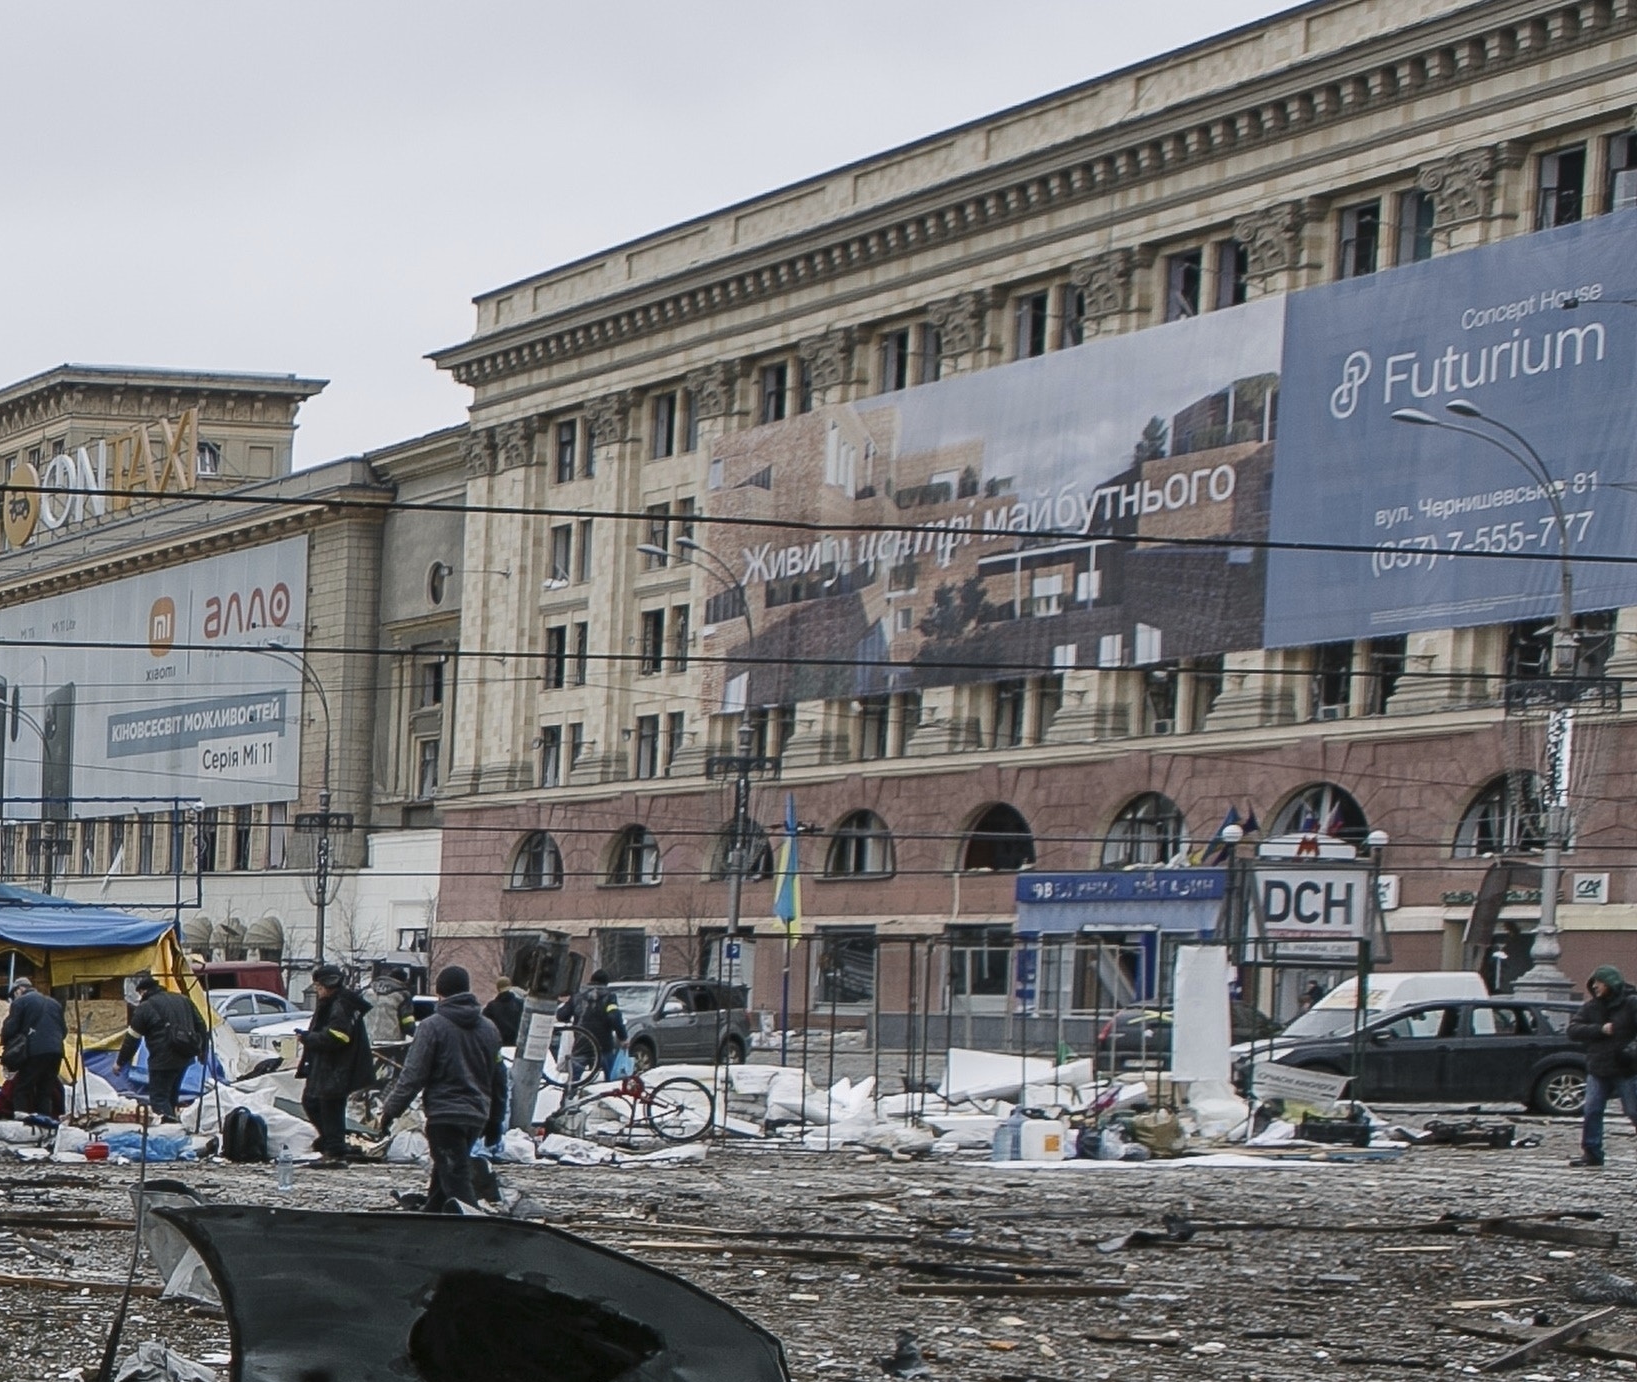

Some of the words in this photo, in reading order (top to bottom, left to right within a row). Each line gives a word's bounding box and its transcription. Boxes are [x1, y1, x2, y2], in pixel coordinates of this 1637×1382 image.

[1461, 296, 1536, 330] Concept
[1539, 282, 1603, 311] House
[1383, 322, 1606, 403] Futurium
[1375, 506, 1413, 530] вул.
[1418, 481, 1566, 520] Чернишевськ,
[1573, 470, 1598, 494] 81
[741, 541, 822, 586] Живи
[858, 499, 975, 577] центрі
[982, 464, 1237, 542] майбутнього
[1372, 534, 1439, 577] (057)
[1446, 510, 1595, 560] 7-555-777
[145, 665, 176, 682] xiaomi
[112, 716, 182, 743] КІНОВСЕСВІТ
[184, 696, 280, 732] МОЖЛИВОСТЕЙ
[202, 746, 239, 773] Серія
[243, 743, 258, 766] Mi
[263, 742, 273, 764] 11
[1264, 880, 1356, 925] DCH
